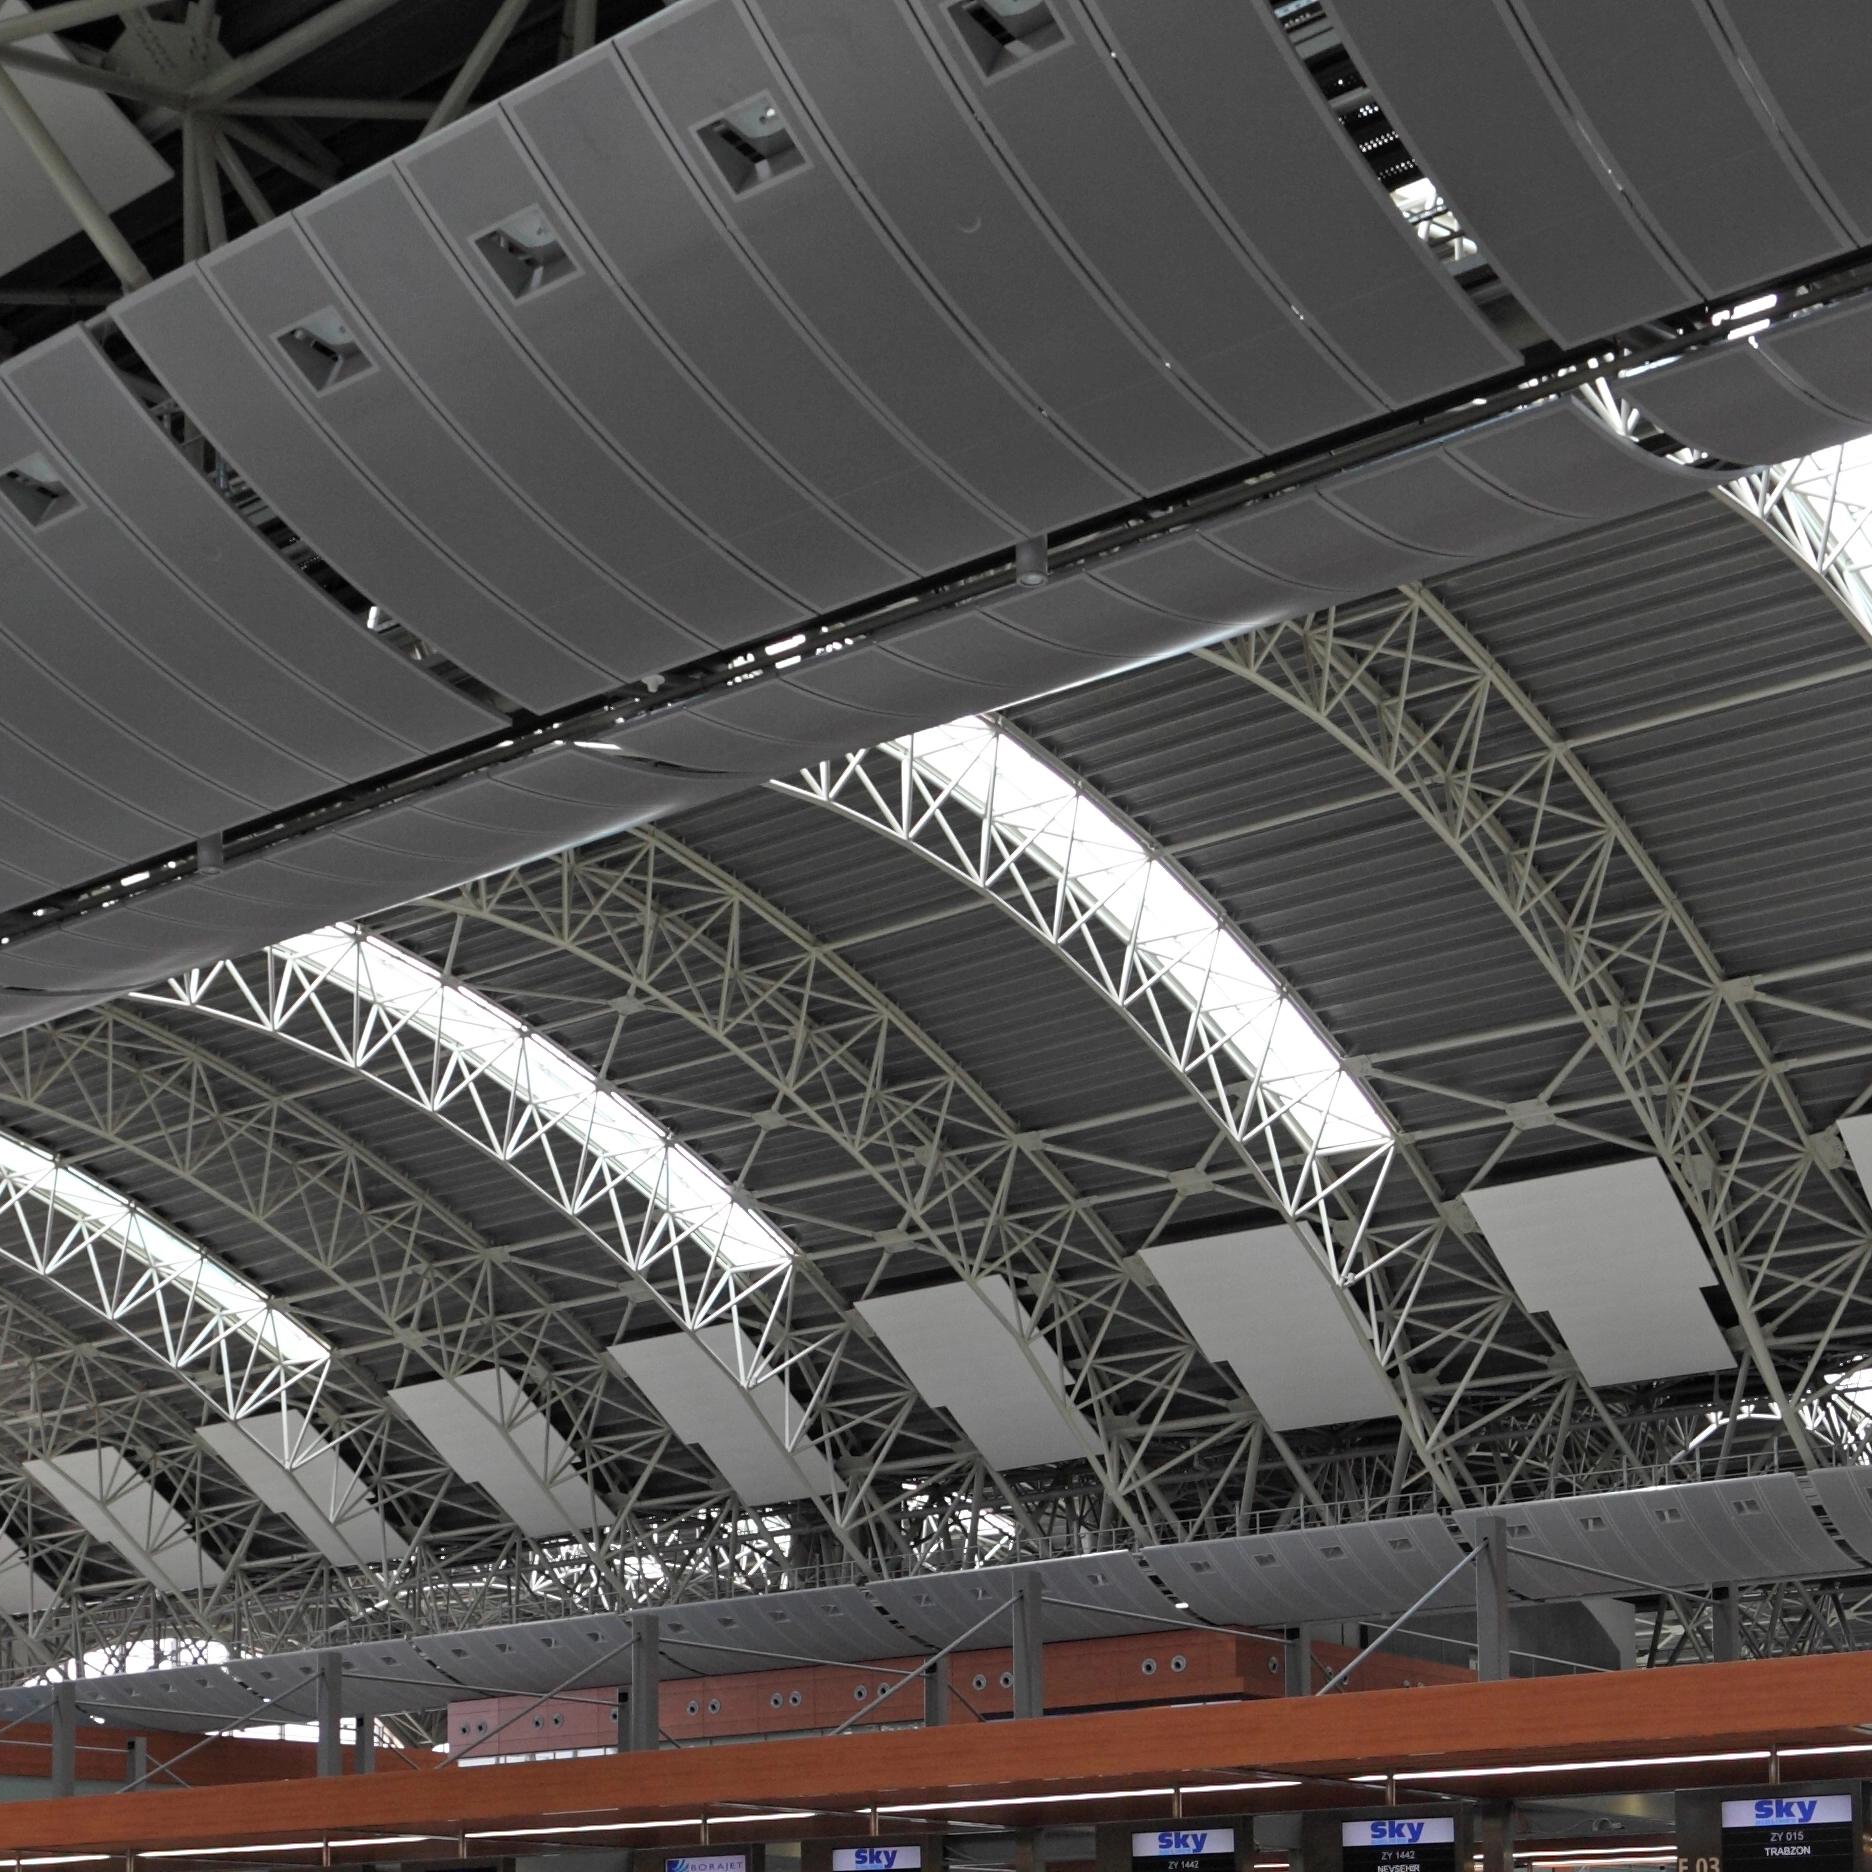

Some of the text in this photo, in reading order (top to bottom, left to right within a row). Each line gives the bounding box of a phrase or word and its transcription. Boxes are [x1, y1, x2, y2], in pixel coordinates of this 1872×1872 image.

[1770, 1833, 1783, 1842] ZY
[1765, 1846, 1811, 1856] TRABZON
[691, 1862, 743, 1872] BORAJET
